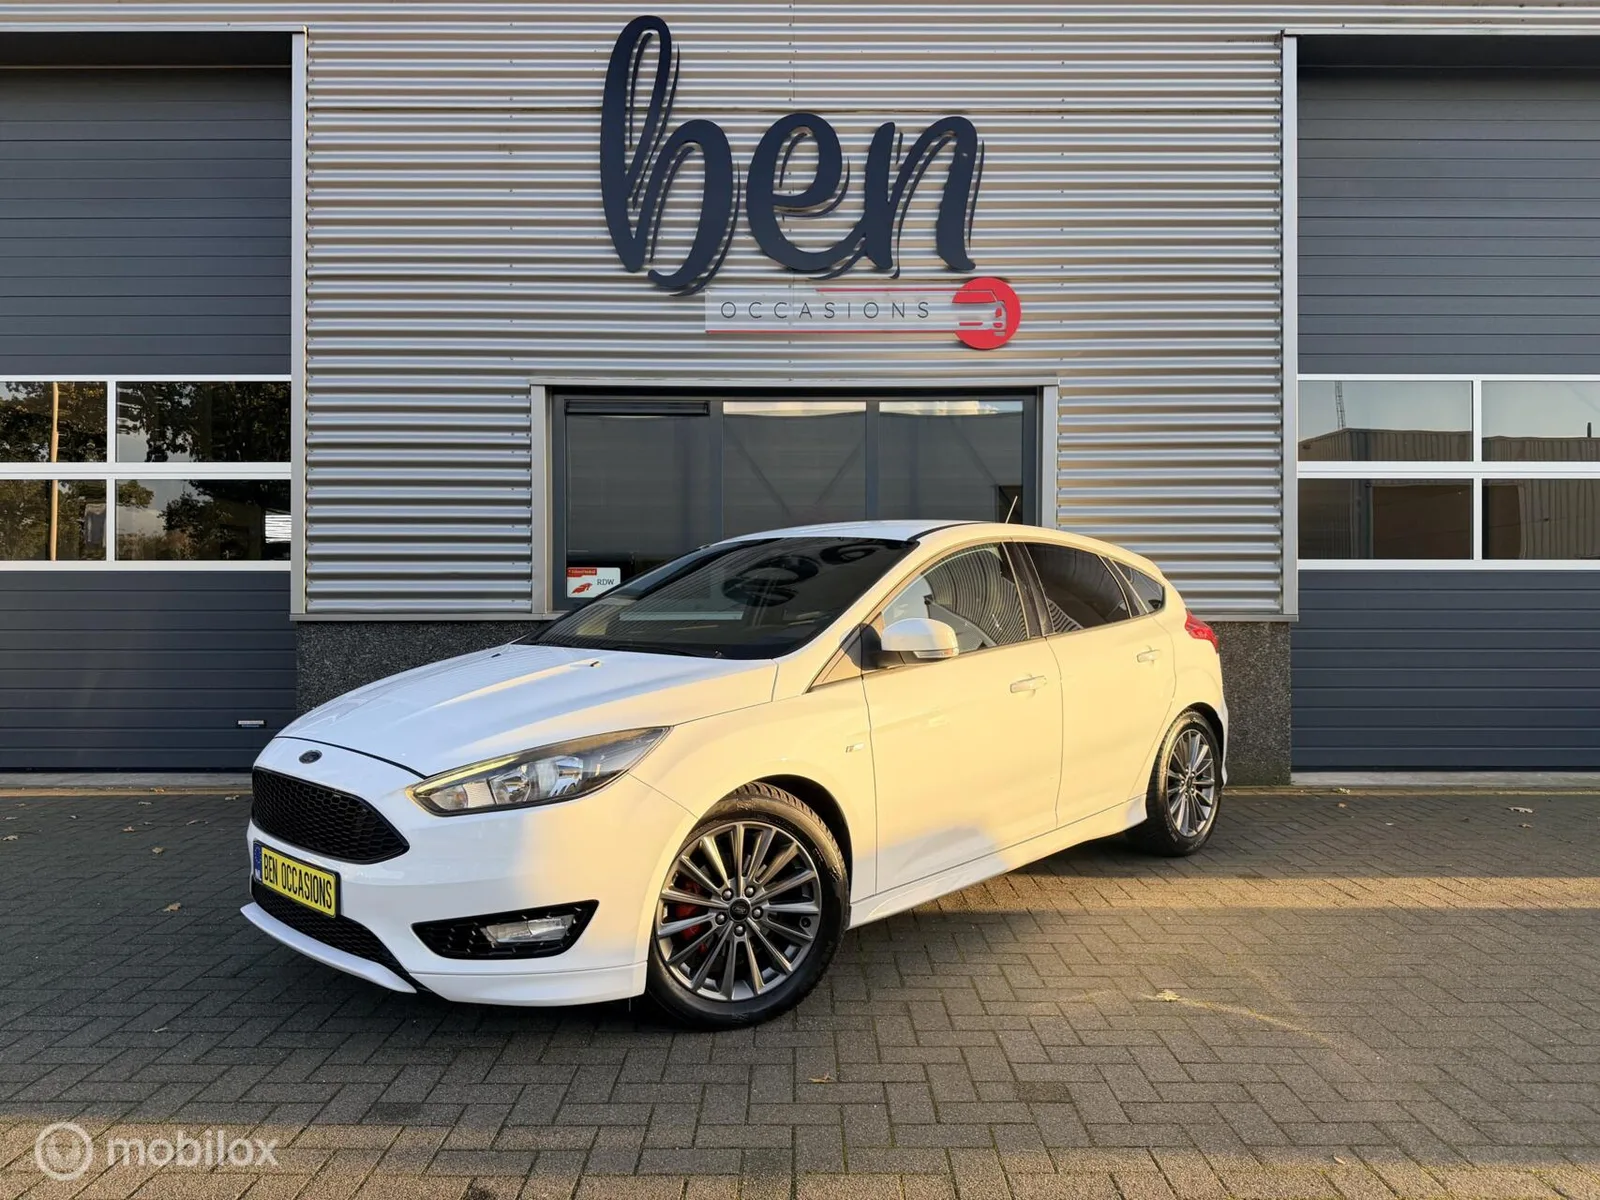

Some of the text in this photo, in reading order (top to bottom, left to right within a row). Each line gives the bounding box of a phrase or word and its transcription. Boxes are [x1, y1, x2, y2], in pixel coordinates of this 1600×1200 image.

[601, 15, 984, 294] ben
[720, 301, 930, 319] OCCASIONS
[264, 854, 332, 910] BEN OCCASIONS
